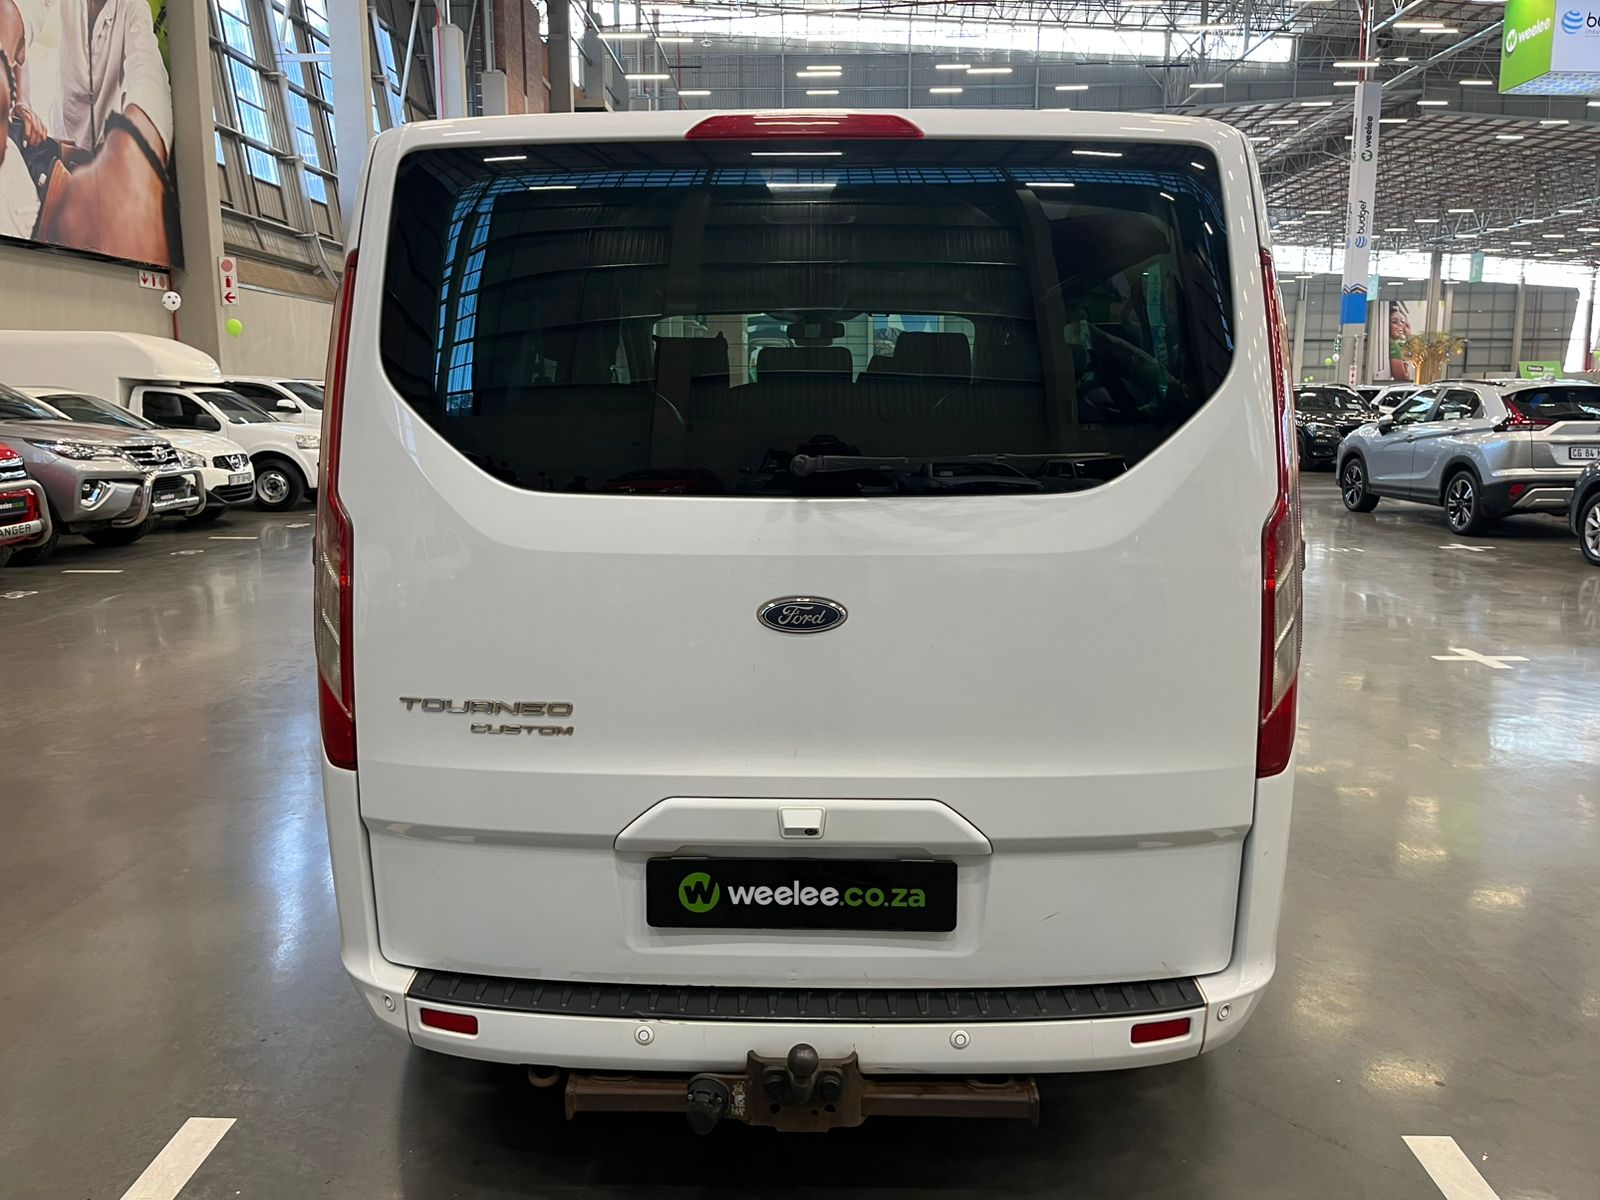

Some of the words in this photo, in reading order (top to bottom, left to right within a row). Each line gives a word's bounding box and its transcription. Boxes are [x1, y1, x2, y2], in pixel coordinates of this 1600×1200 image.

[1518, 17, 1551, 43] weelee
[1364, 115, 1374, 149] weelee
[1356, 199, 1370, 235] budget
[777, 605, 826, 625] Ford
[399, 696, 574, 717] TOURNEO
[470, 722, 575, 737] CUSTOM
[727, 880, 926, 907] weelee.co.za
